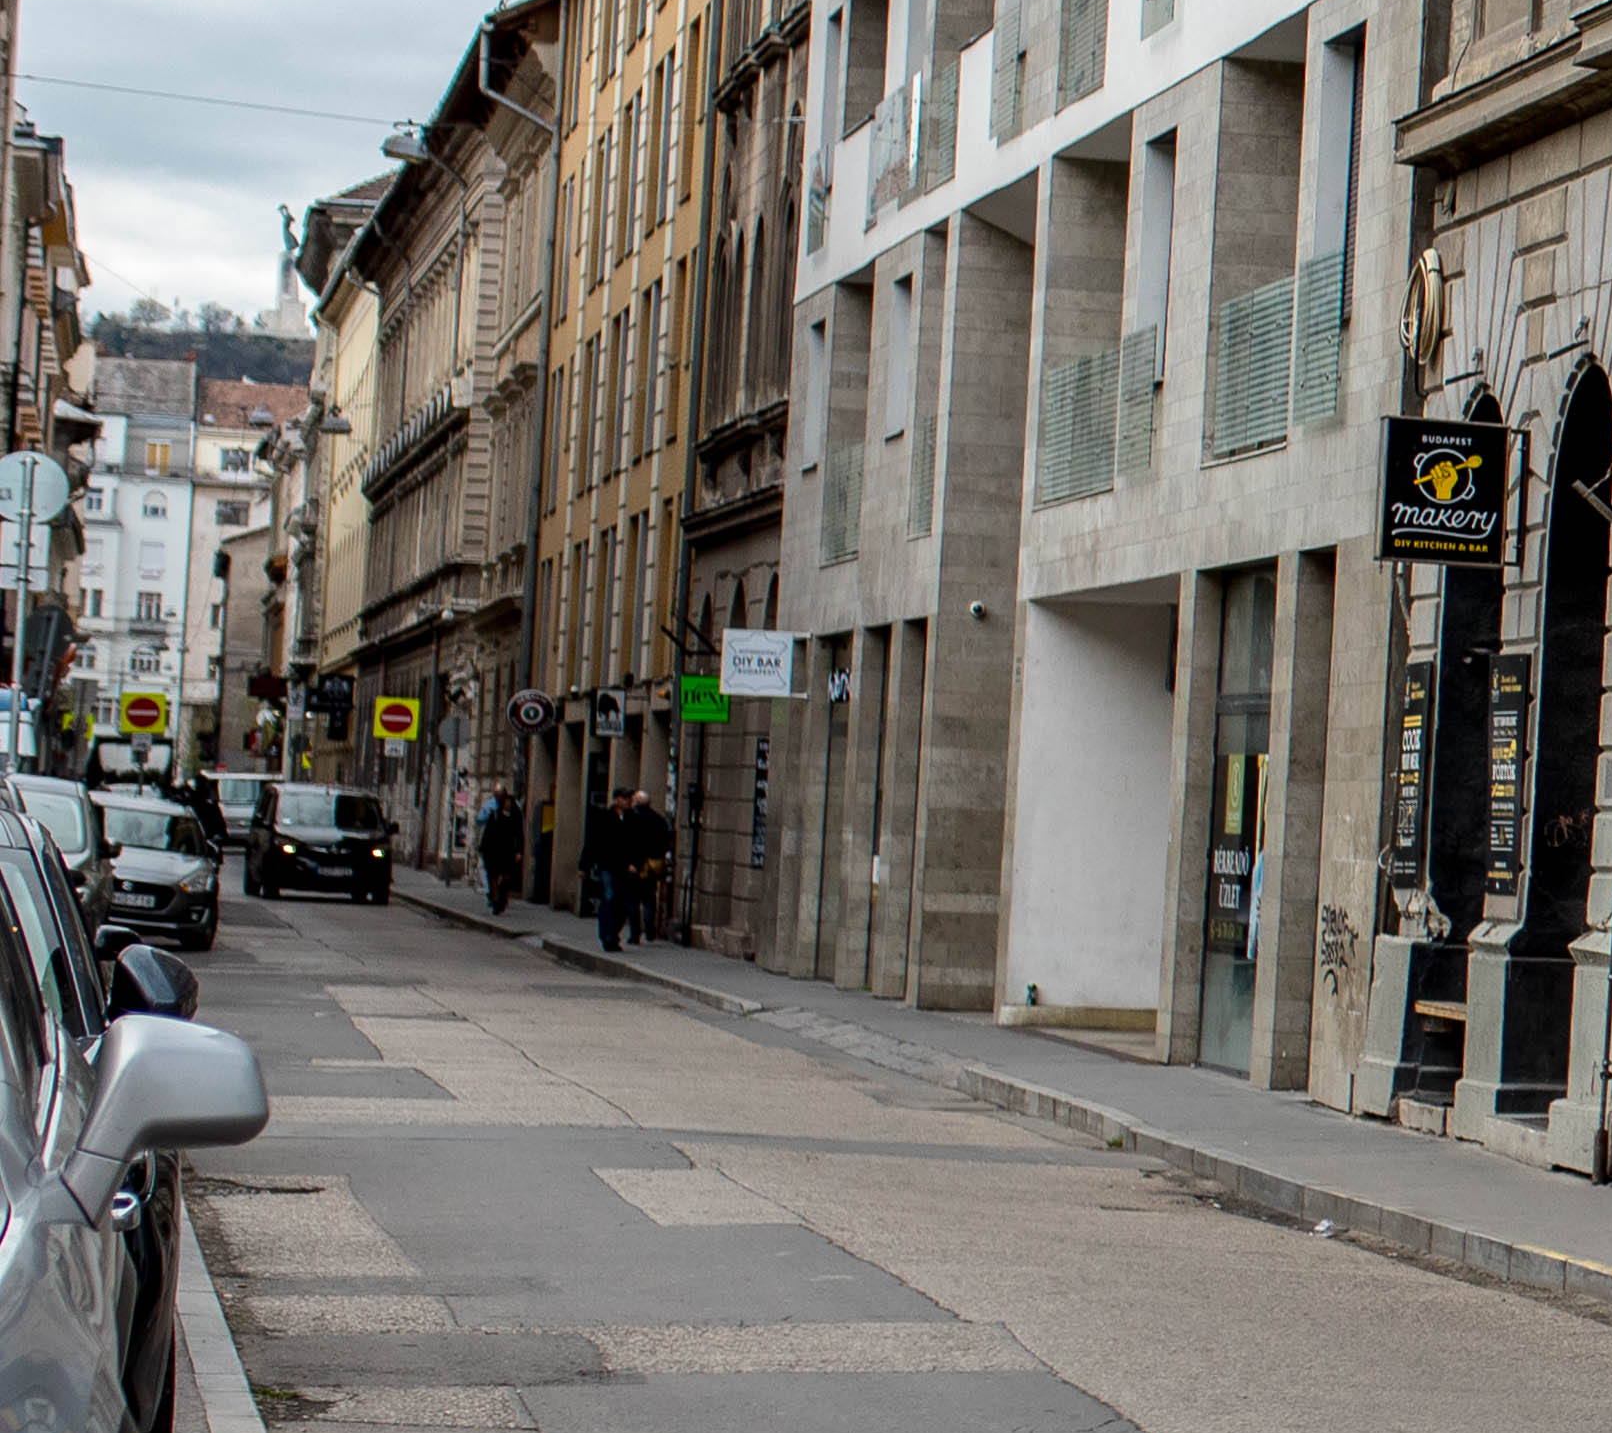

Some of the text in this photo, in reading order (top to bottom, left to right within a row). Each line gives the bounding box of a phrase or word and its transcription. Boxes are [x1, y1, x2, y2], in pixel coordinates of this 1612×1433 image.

[1422, 434, 1472, 446] BUDAPEST
[1392, 502, 1497, 539] makery
[1394, 538, 1488, 552] DIY KITCHEN & BAR
[732, 655, 781, 668] DIY BAR
